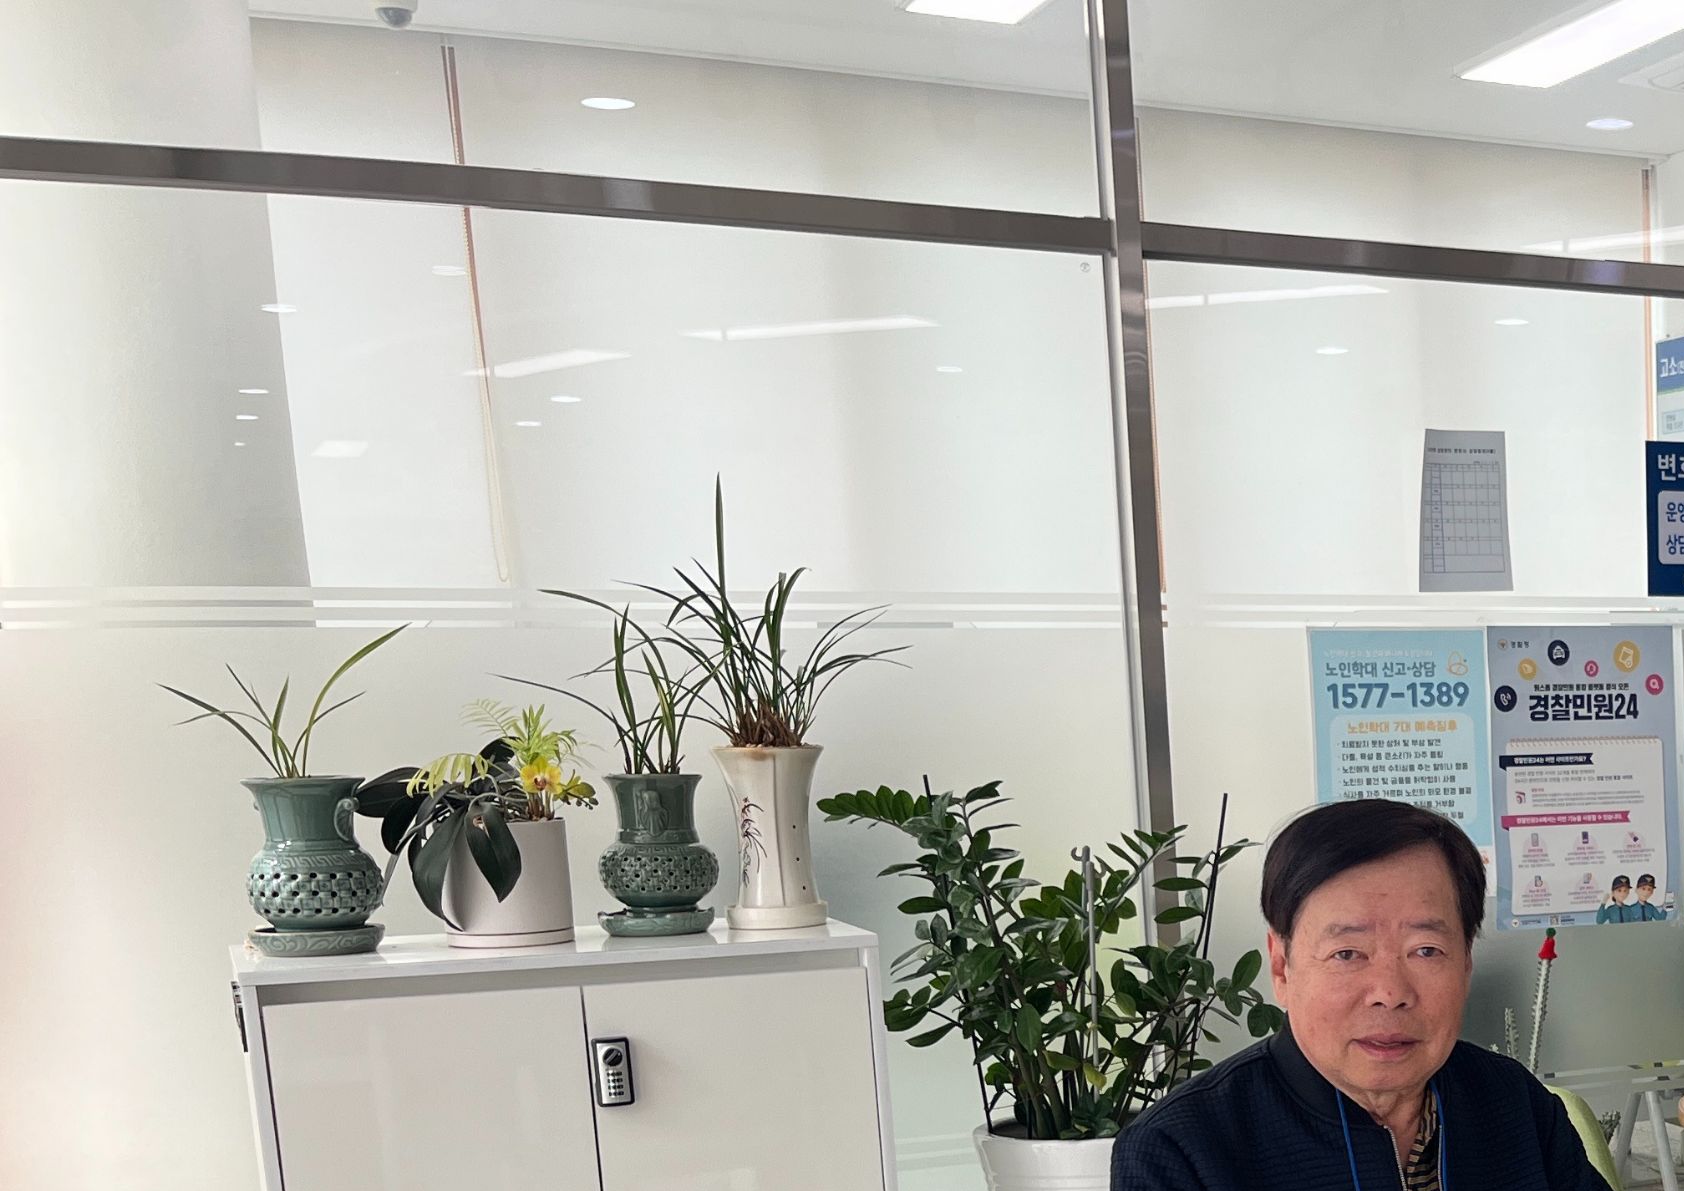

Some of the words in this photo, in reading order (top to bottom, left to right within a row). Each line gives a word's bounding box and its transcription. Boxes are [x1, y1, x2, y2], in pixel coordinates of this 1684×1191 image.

[1325, 662, 1377, 678] 노인학대
[1382, 662, 1436, 678] 신고·상담
[1327, 681, 1469, 709] 1577-1389
[1529, 693, 1639, 722] 경찰민원24
[1348, 721, 1390, 734] 노인학대
[1394, 720, 1411, 732] 7대
